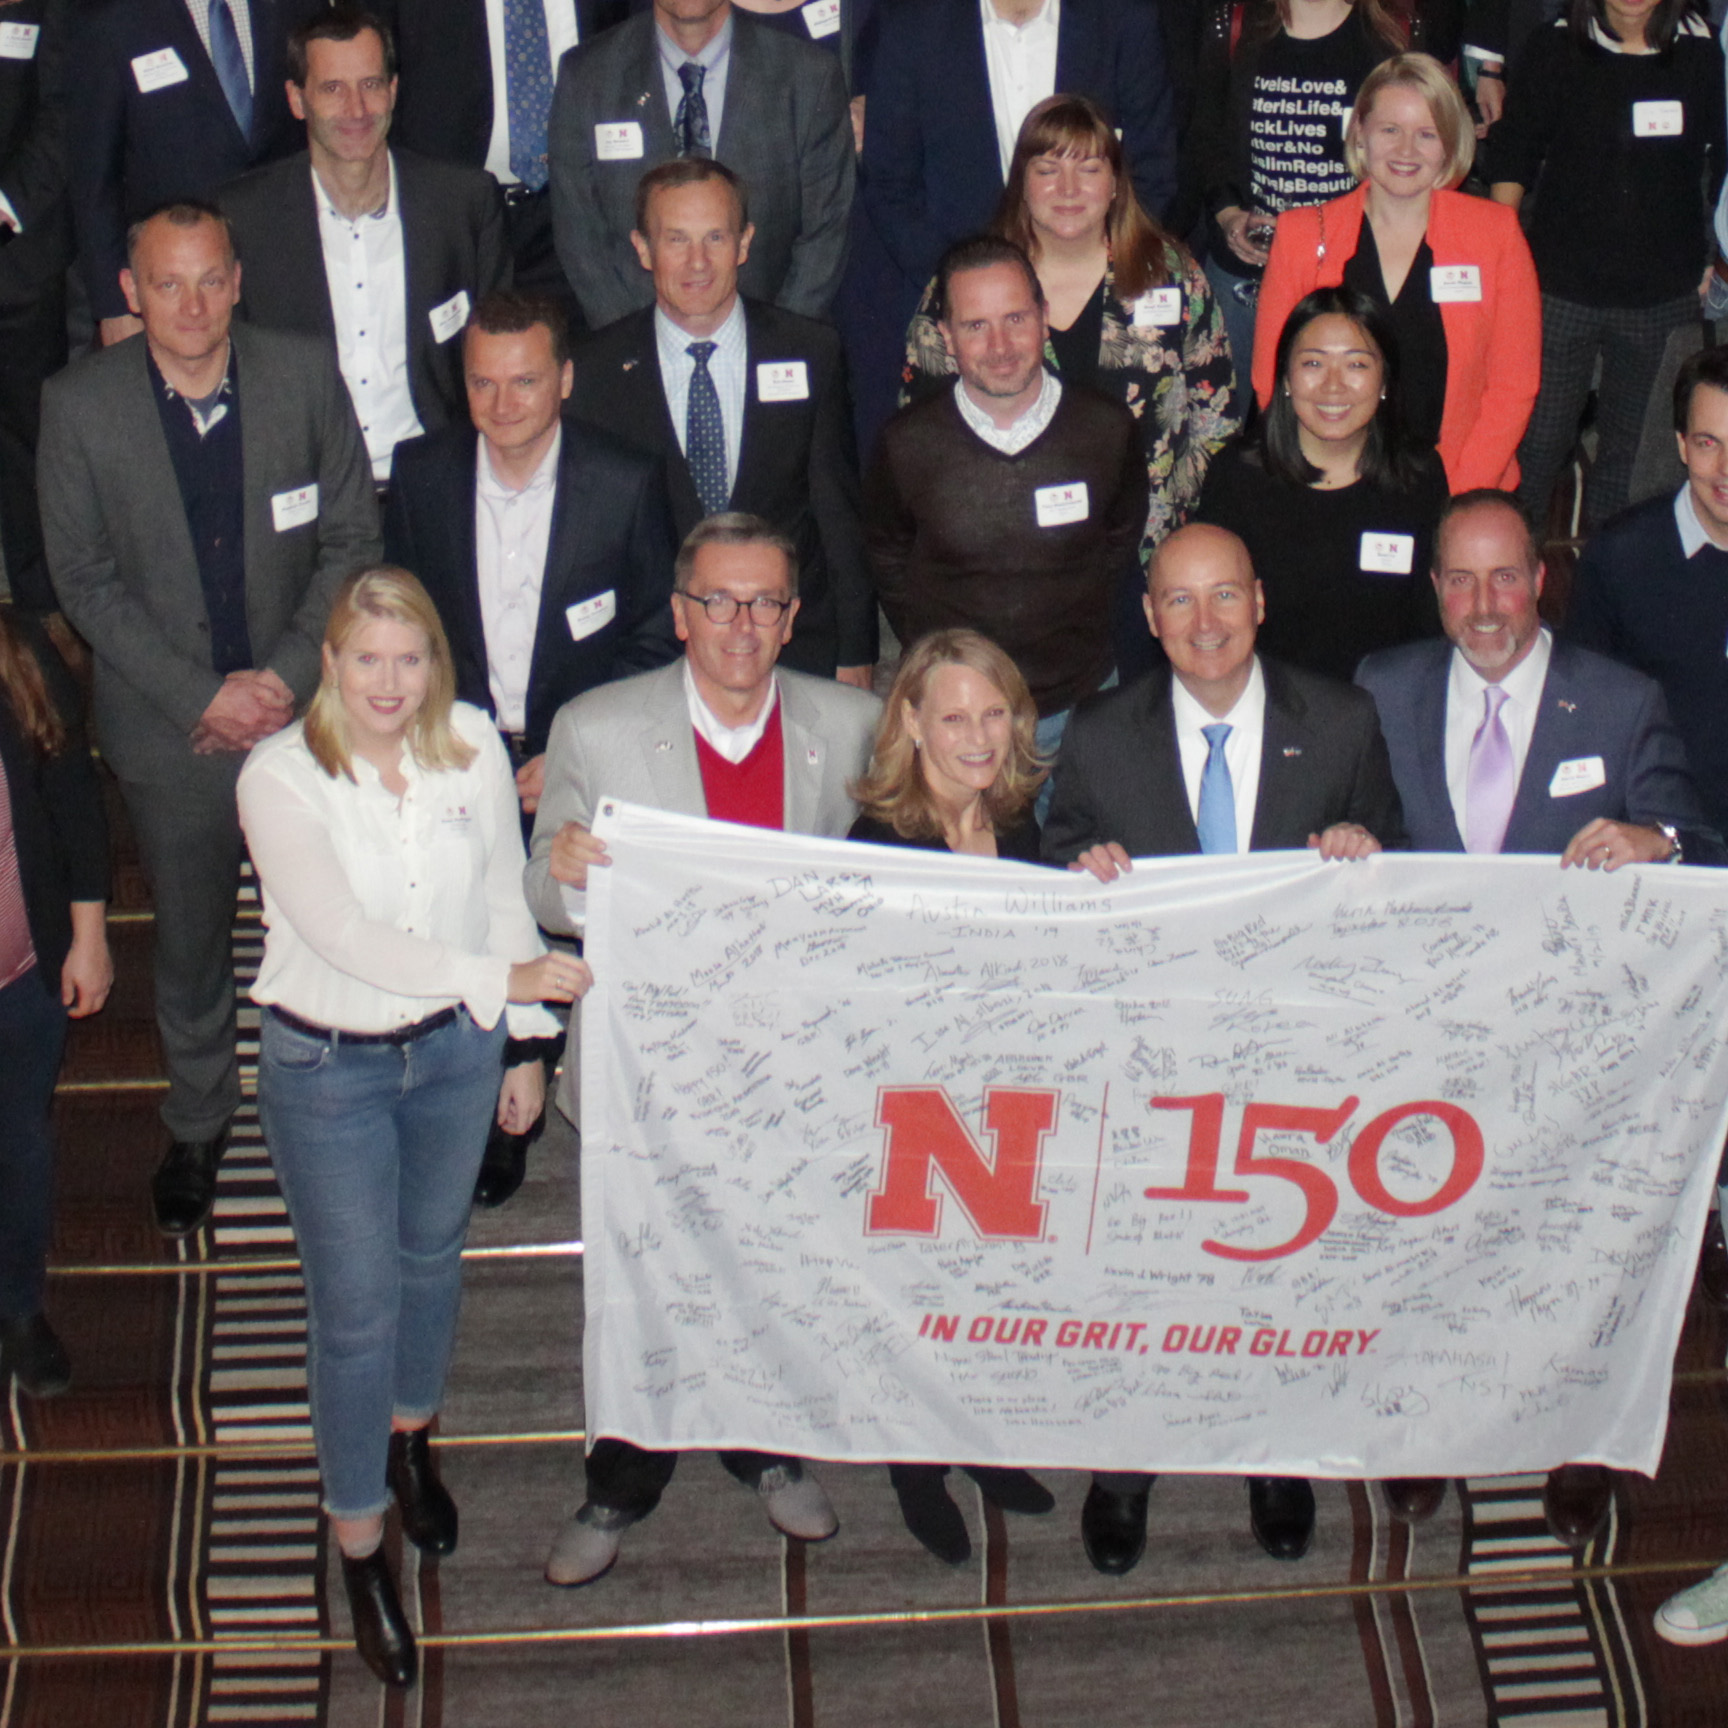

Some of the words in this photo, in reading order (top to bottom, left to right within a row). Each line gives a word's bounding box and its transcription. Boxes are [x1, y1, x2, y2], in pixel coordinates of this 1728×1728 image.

[766, 870, 819, 899] DAN
[906, 892, 984, 924] Austin
[1005, 886, 1113, 917] Williams
[863, 1084, 1061, 1243] N
[1144, 1092, 1485, 1263] 150
[1150, 1269, 1193, 1286] Wright
[918, 1313, 961, 1343] IN
[967, 1316, 1048, 1347] OUR
[1054, 1320, 1149, 1355] GRIT,
[1161, 1323, 1243, 1355] OUR
